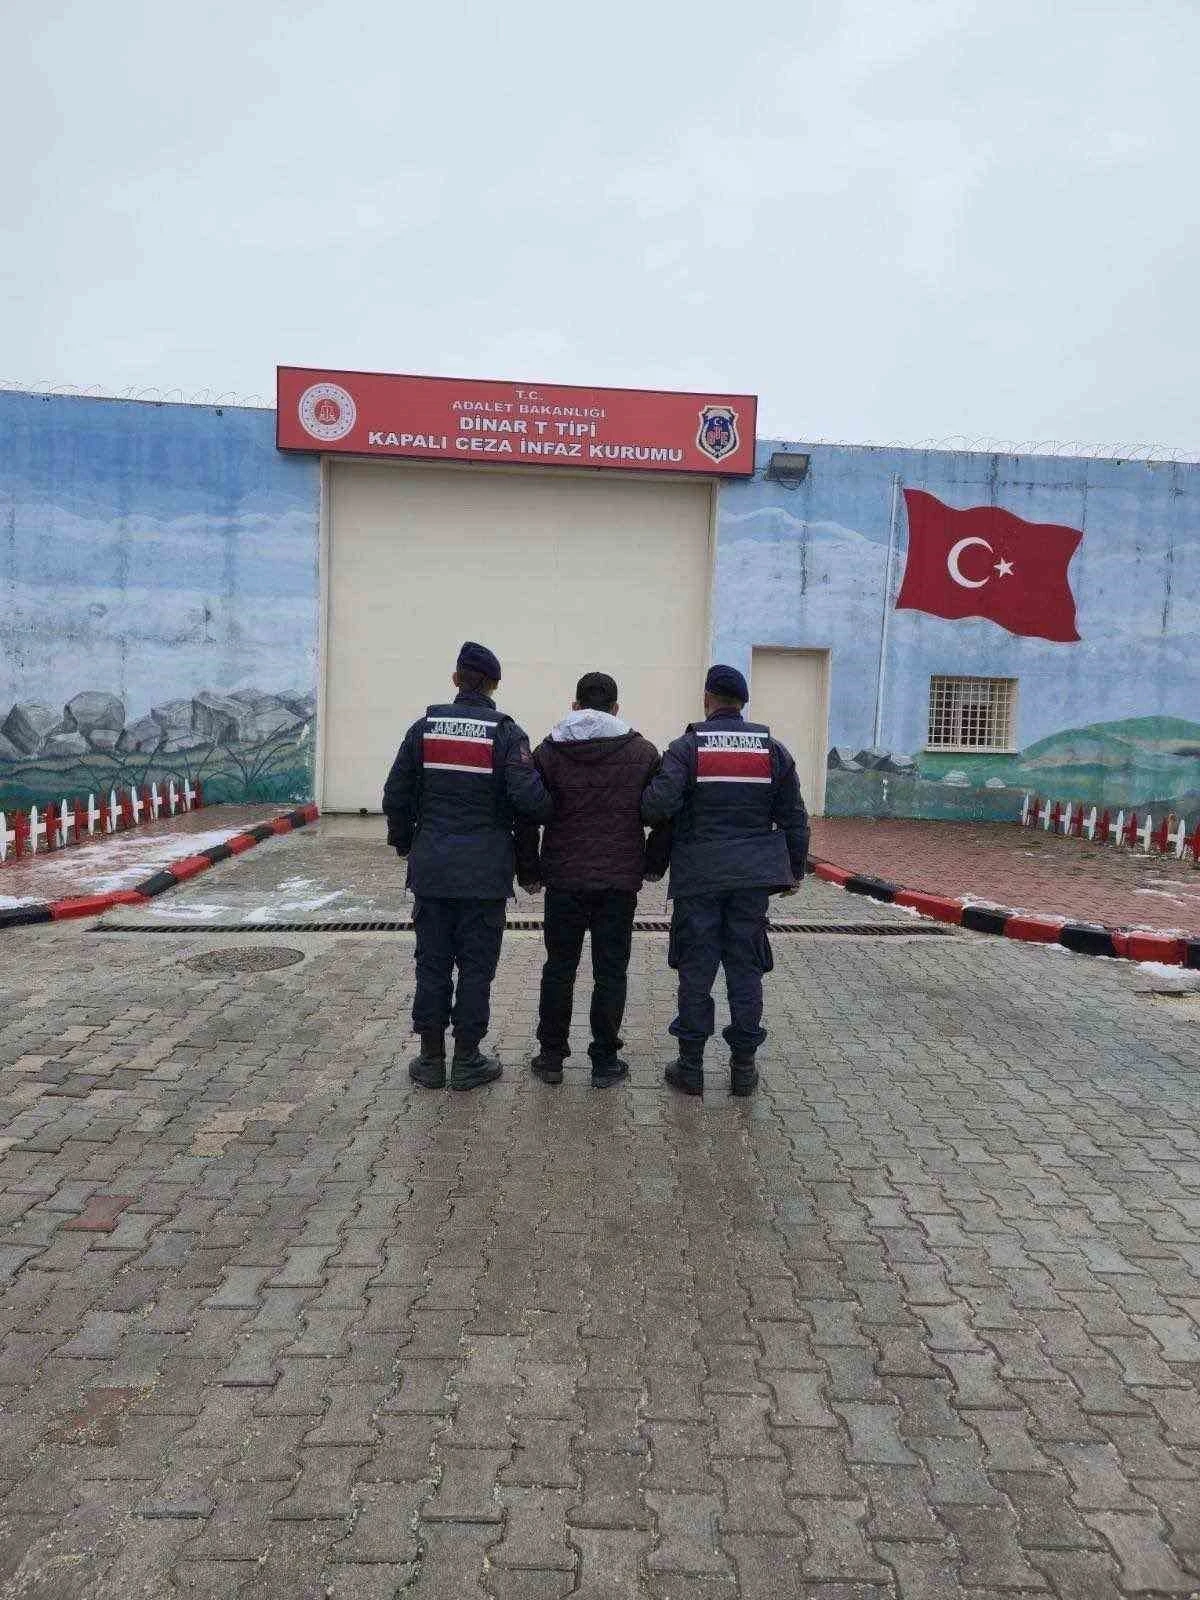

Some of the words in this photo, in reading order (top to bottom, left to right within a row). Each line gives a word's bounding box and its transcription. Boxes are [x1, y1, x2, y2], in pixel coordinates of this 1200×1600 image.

[452, 400, 514, 413] ADALET
[459, 415, 527, 433] DİNAR
[534, 421, 547, 434] T
[555, 420, 596, 437] TİPİ
[368, 431, 448, 449] KAPALI
[455, 437, 513, 453] CEZA
[520, 437, 582, 457] İNFAZ
[589, 444, 683, 462] KURUMU
[433, 721, 487, 737] JANDARMA
[704, 736, 762, 749] JANDARMA
